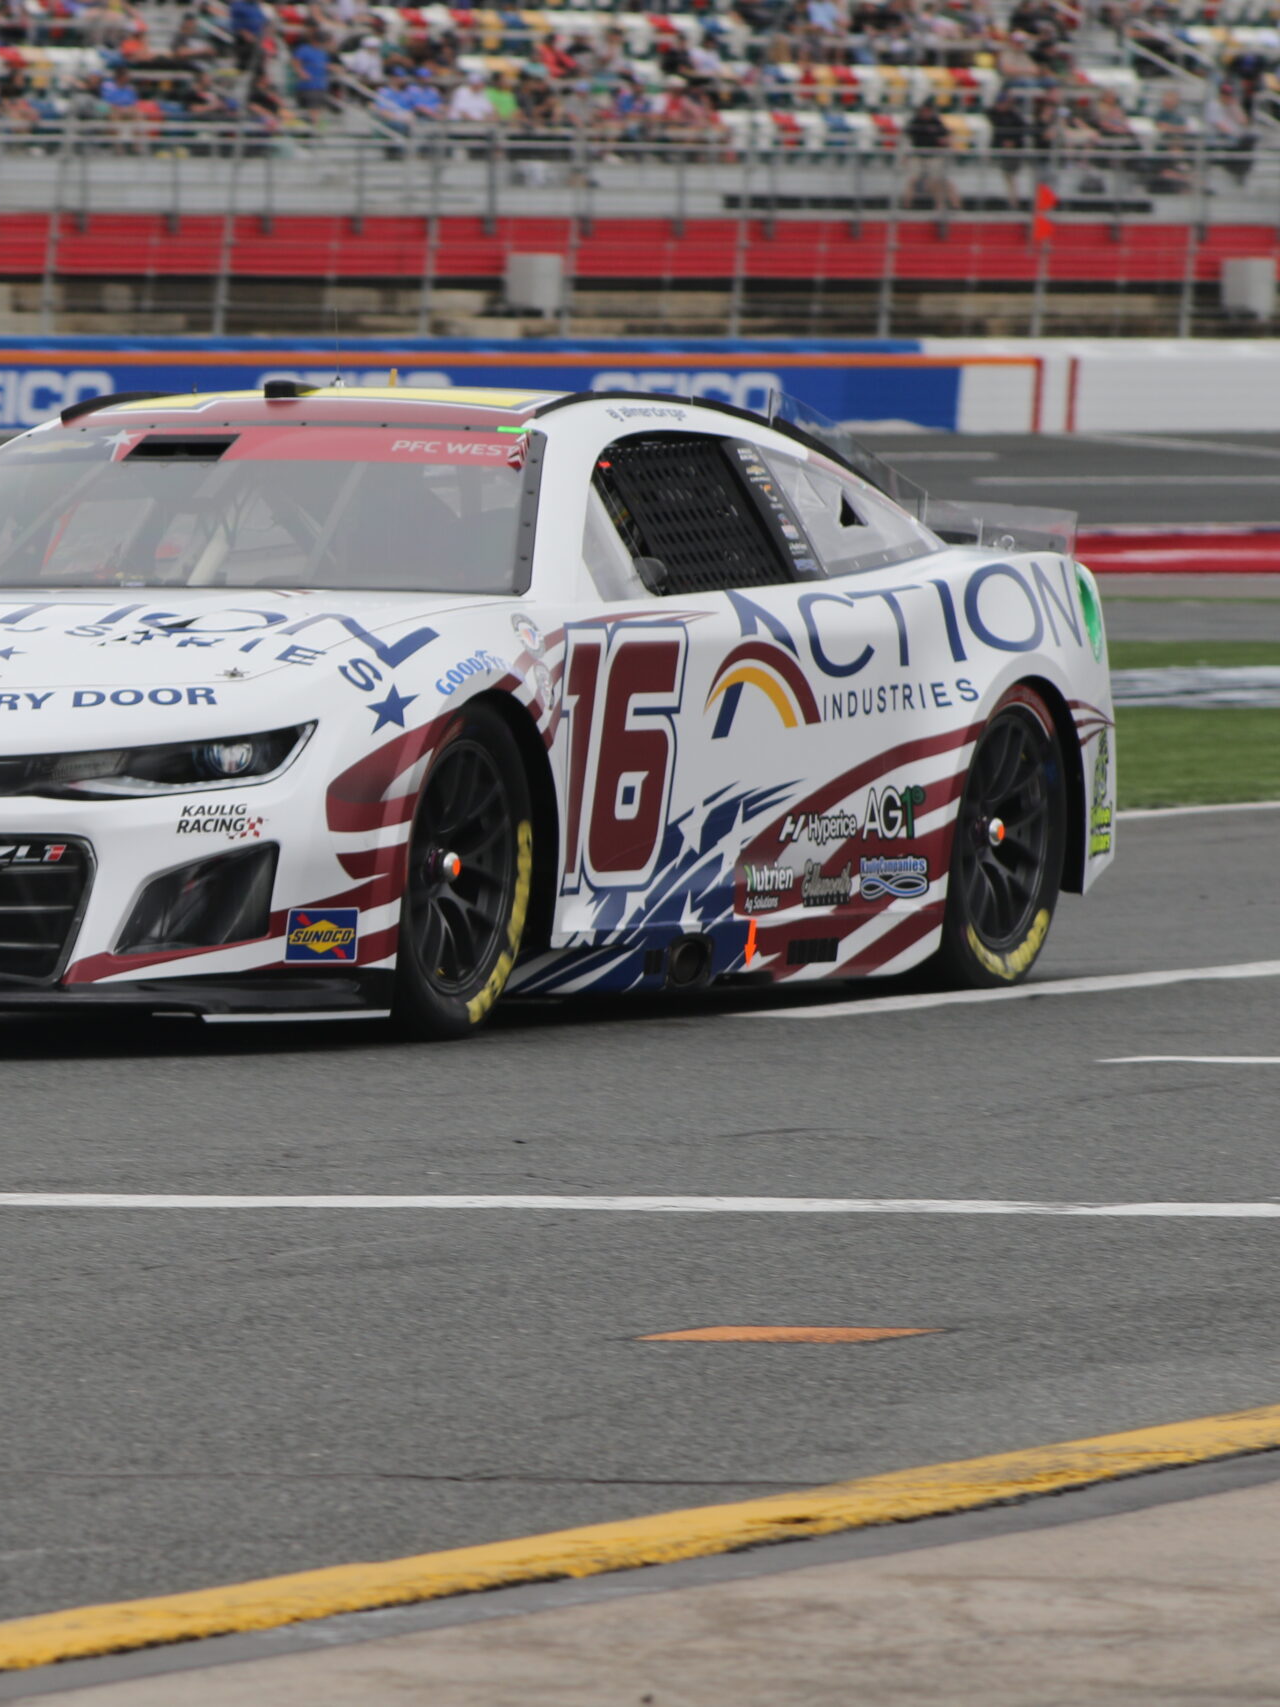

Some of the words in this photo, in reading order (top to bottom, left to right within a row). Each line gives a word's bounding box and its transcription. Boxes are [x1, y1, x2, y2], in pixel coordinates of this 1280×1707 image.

[391, 440, 441, 454] PFC
[447, 442, 520, 457] WEST
[72, 687, 217, 707] DOOR
[823, 678, 978, 721] INDUSTRIES
[560, 621, 690, 896] 16
[181, 804, 247, 817] KAULIG
[176, 818, 246, 833] RACING
[808, 810, 858, 844] Hyperice
[744, 863, 794, 892] Nutrien
[292, 929, 352, 943] SUNOCO
